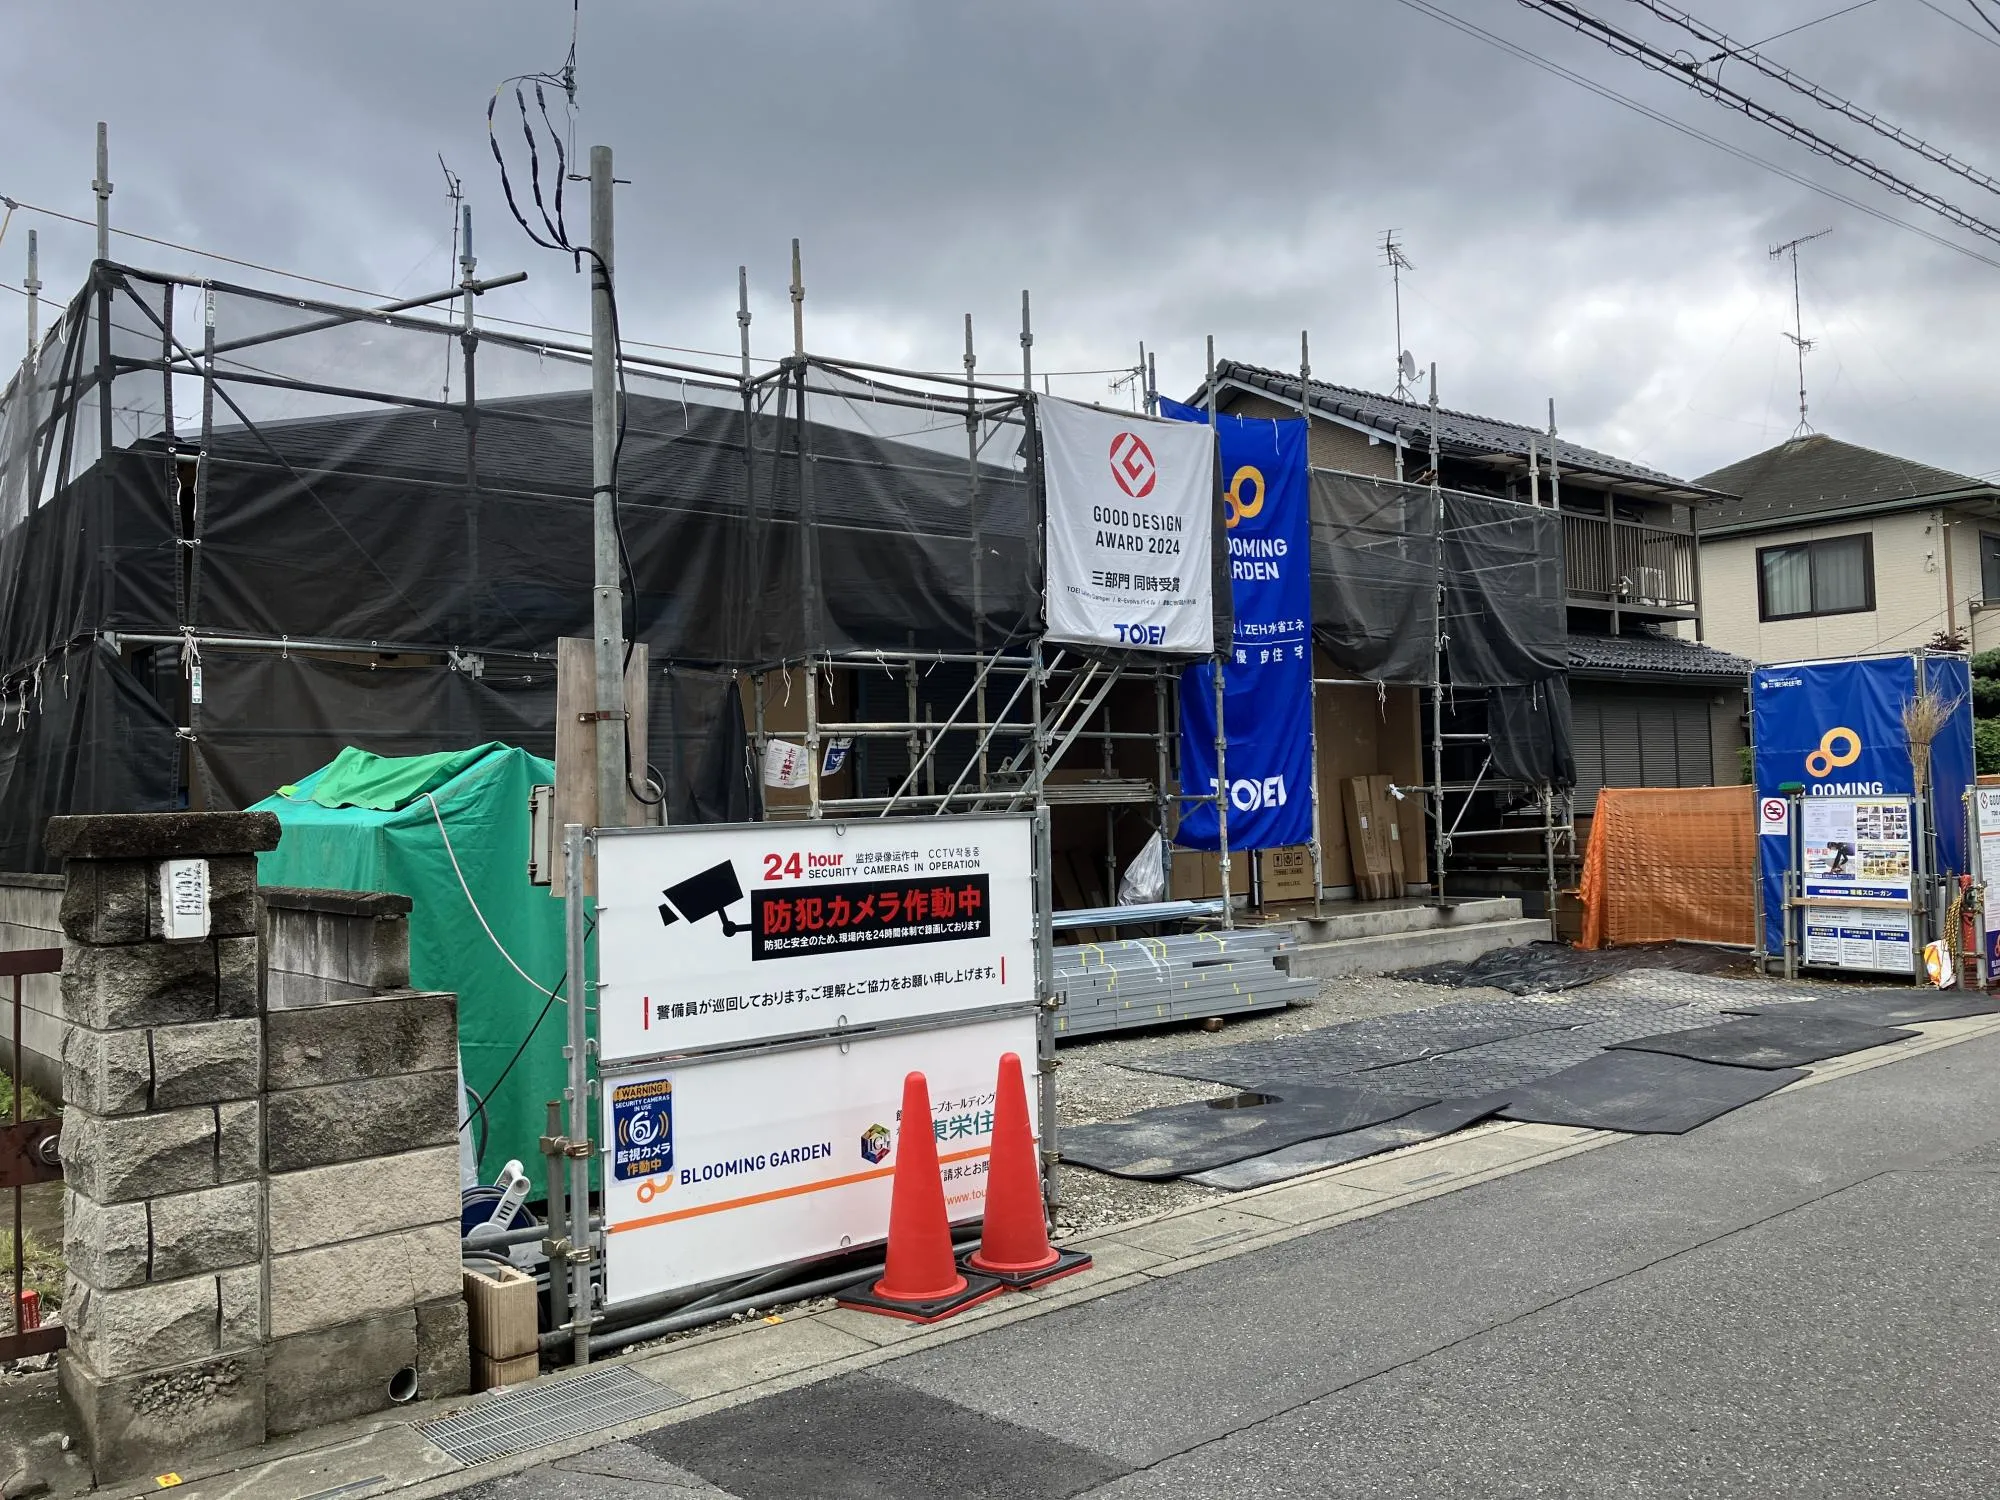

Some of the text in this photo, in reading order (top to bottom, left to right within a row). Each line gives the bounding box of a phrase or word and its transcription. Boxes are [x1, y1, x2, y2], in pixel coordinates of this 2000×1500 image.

[1093, 505, 1182, 532] GOOD DESIGN
[1095, 531, 1181, 555] AWARD 2024
[1091, 570, 1181, 593] 三部門 同時受賞
[1231, 561, 1279, 580] RDEN
[1113, 623, 1166, 645] TOEI
[1802, 781, 1883, 795] OOMING
[763, 852, 843, 881] 24 hour
[808, 859, 980, 879] SECURITY CAMERAS IN OPERATION
[855, 851, 919, 865] 监控录像运作中
[763, 884, 981, 935] 防犯カメラ作動中
[764, 920, 982, 951] 防犯と安全のため、現場内を24時間体制で録画しております
[656, 966, 996, 1020] 警備員が巡回しております。ご理解とご協力をお願い申し上げます。
[615, 1095, 670, 1109] SECURITY CAMERAS
[622, 1084, 662, 1098] WARNING
[617, 1142, 670, 1164] 監視カメラ
[680, 1142, 832, 1186] BLOOMING GARDEN
[627, 1158, 661, 1176] 作動中
[940, 1160, 990, 1181] 請求とお問
